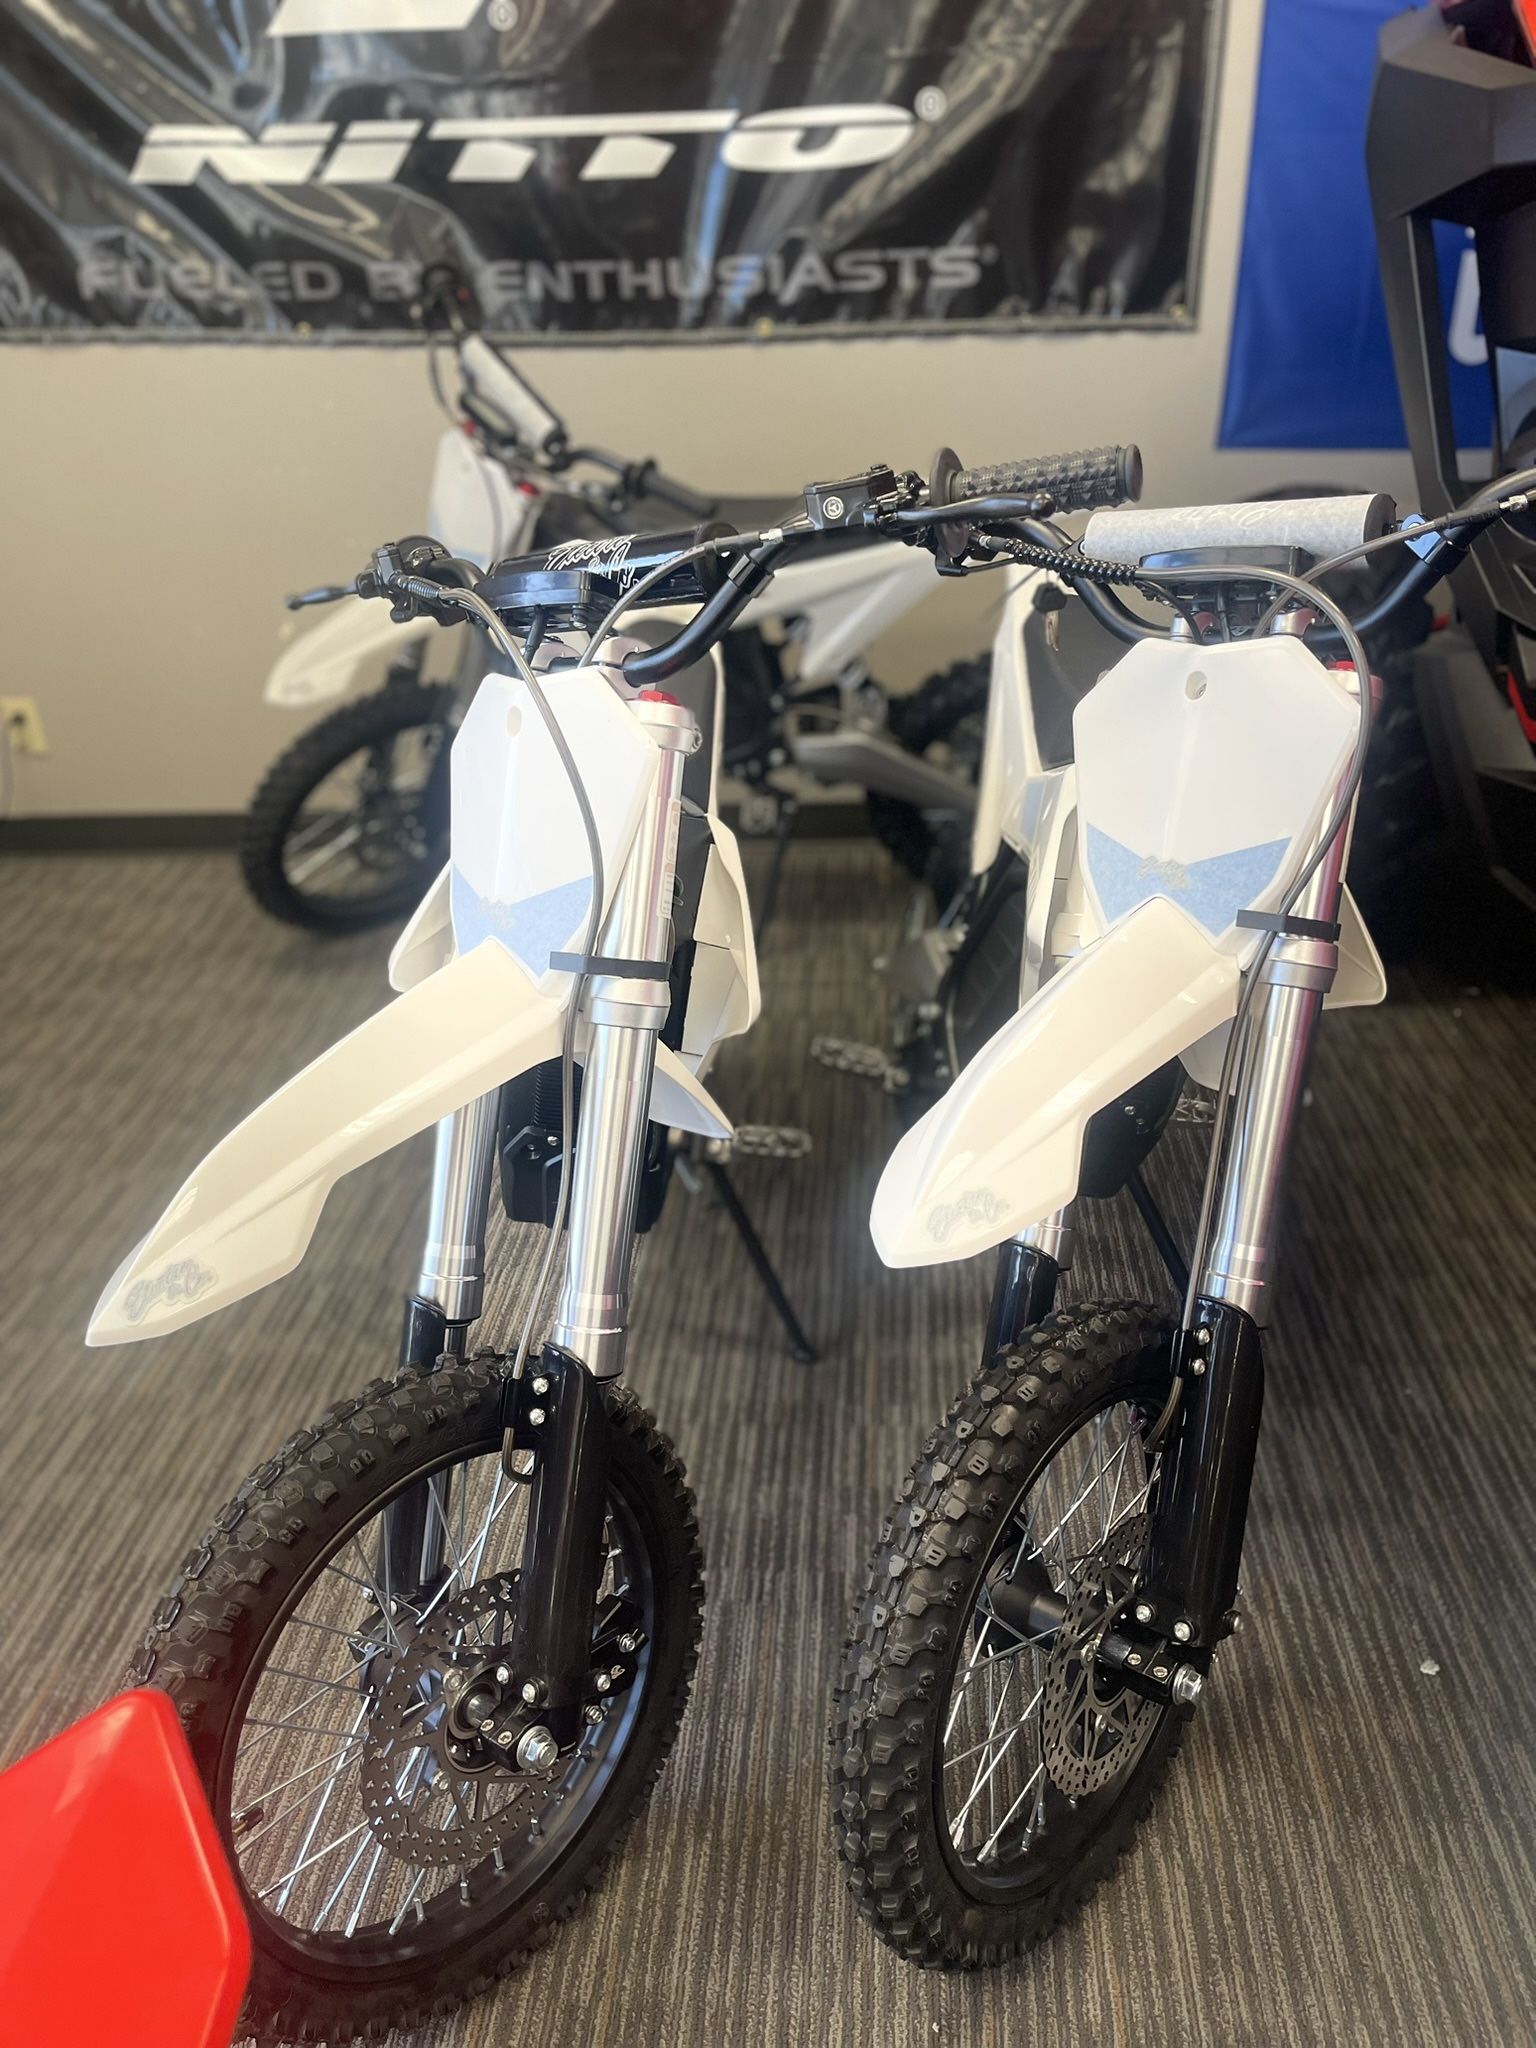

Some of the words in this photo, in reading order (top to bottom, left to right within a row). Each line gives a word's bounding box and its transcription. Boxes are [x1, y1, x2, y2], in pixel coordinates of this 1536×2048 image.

[78, 259, 342, 301] FUELED
[366, 260, 430, 301] B
[484, 245, 981, 304] ENTHUSIASTS
